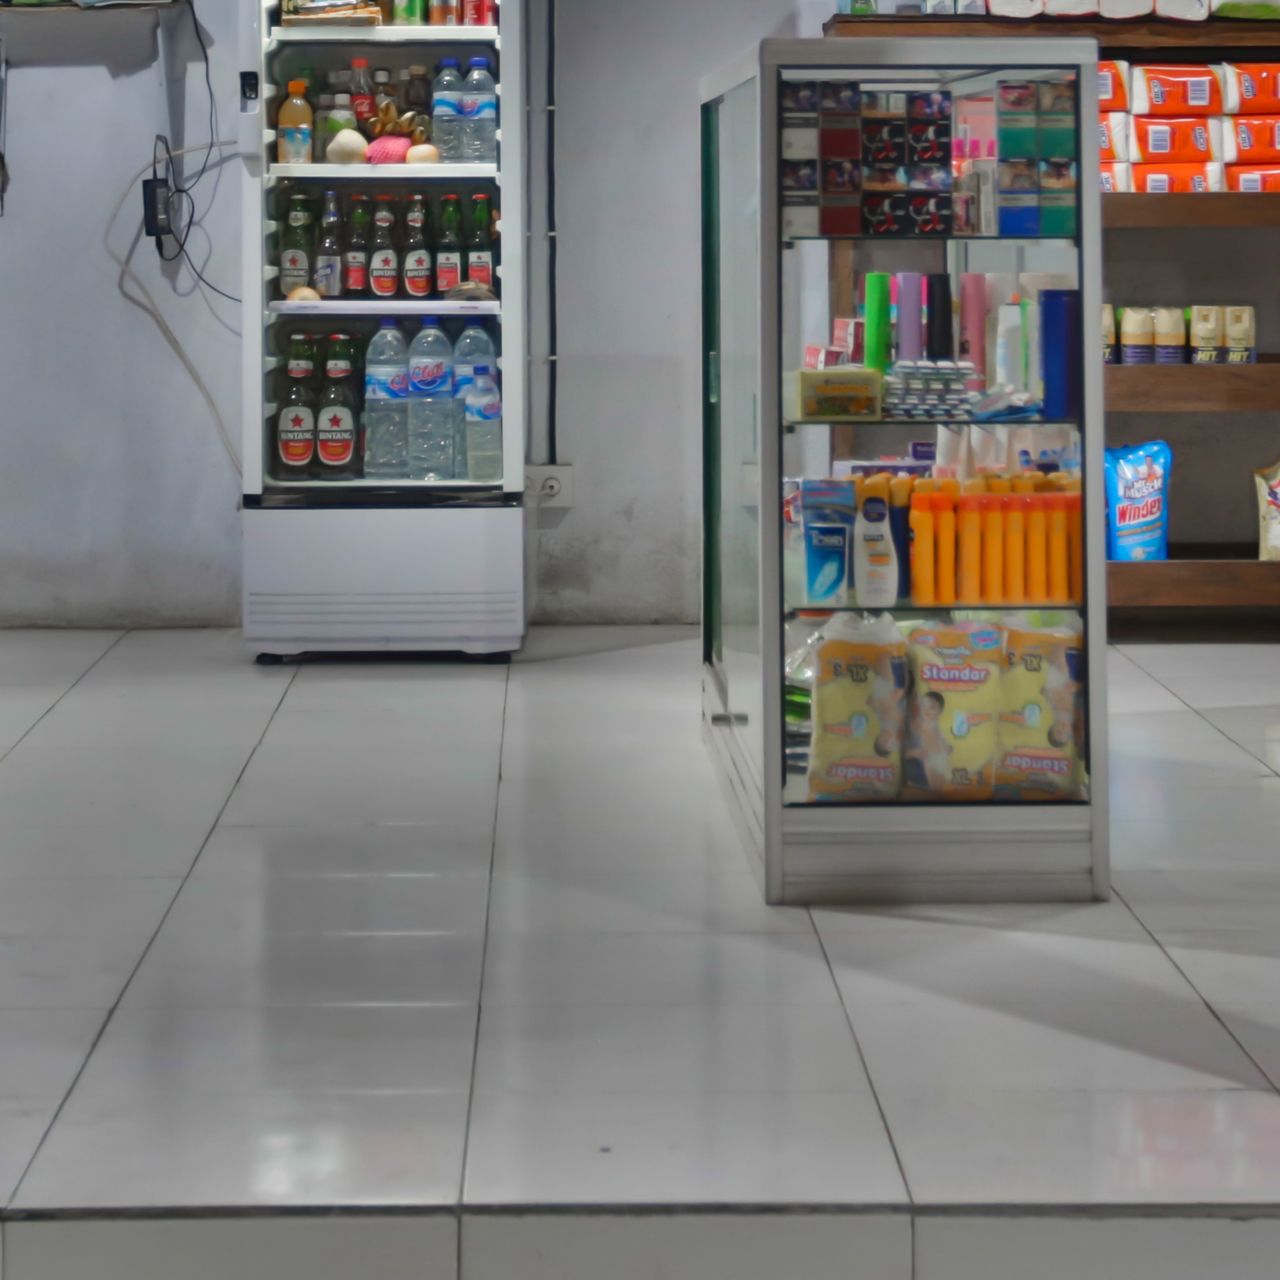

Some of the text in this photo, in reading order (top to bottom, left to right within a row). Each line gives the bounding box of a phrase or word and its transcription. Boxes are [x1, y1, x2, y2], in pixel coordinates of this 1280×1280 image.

[1197, 351, 1217, 361] HIT
[1228, 351, 1248, 361] HIT
[280, 431, 313, 440] BINTANG
[319, 431, 352, 440] BINTANG
[922, 665, 987, 681] Standar
